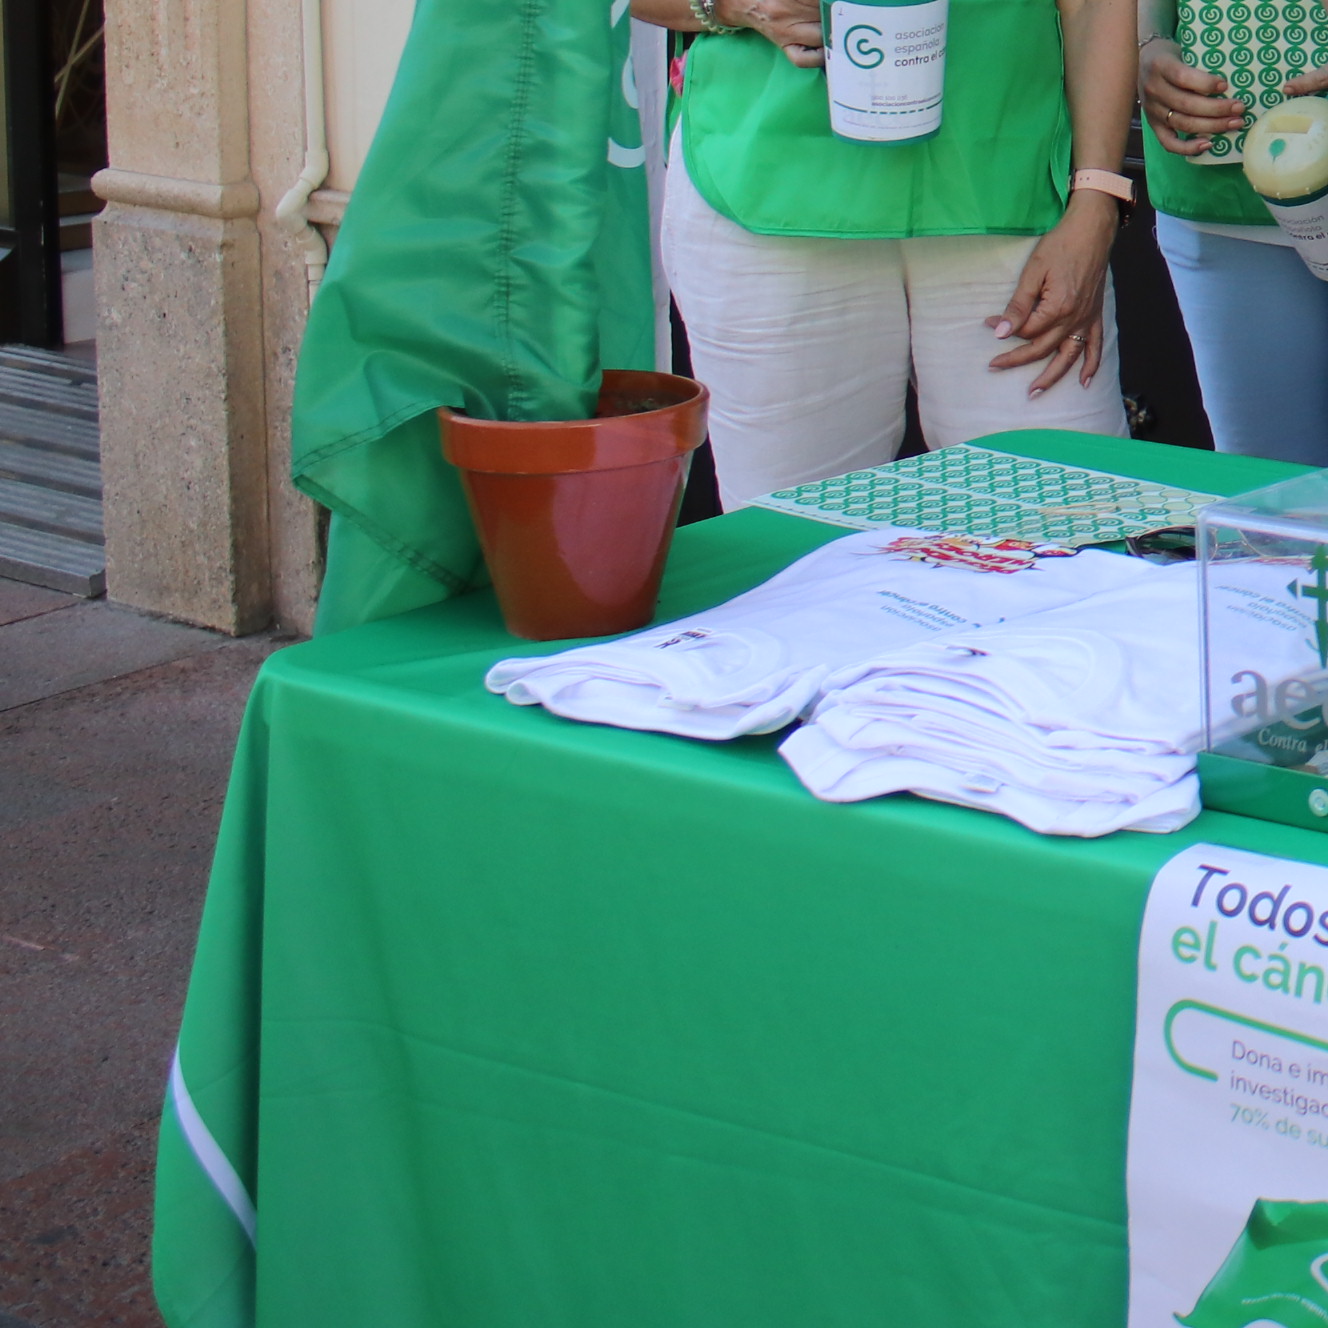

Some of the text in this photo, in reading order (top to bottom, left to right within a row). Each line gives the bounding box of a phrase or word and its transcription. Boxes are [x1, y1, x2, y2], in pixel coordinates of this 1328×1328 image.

[895, 38, 939, 54] española
[895, 56, 929, 67] contra
[931, 51, 937, 60] el
[1258, 727, 1307, 753] Contra
[1171, 921, 1218, 972] el
[1231, 1040, 1283, 1074] Dona
[1288, 1062, 1301, 1080] e
[1229, 1103, 1270, 1131] 70%
[1275, 1116, 1302, 1140] de
